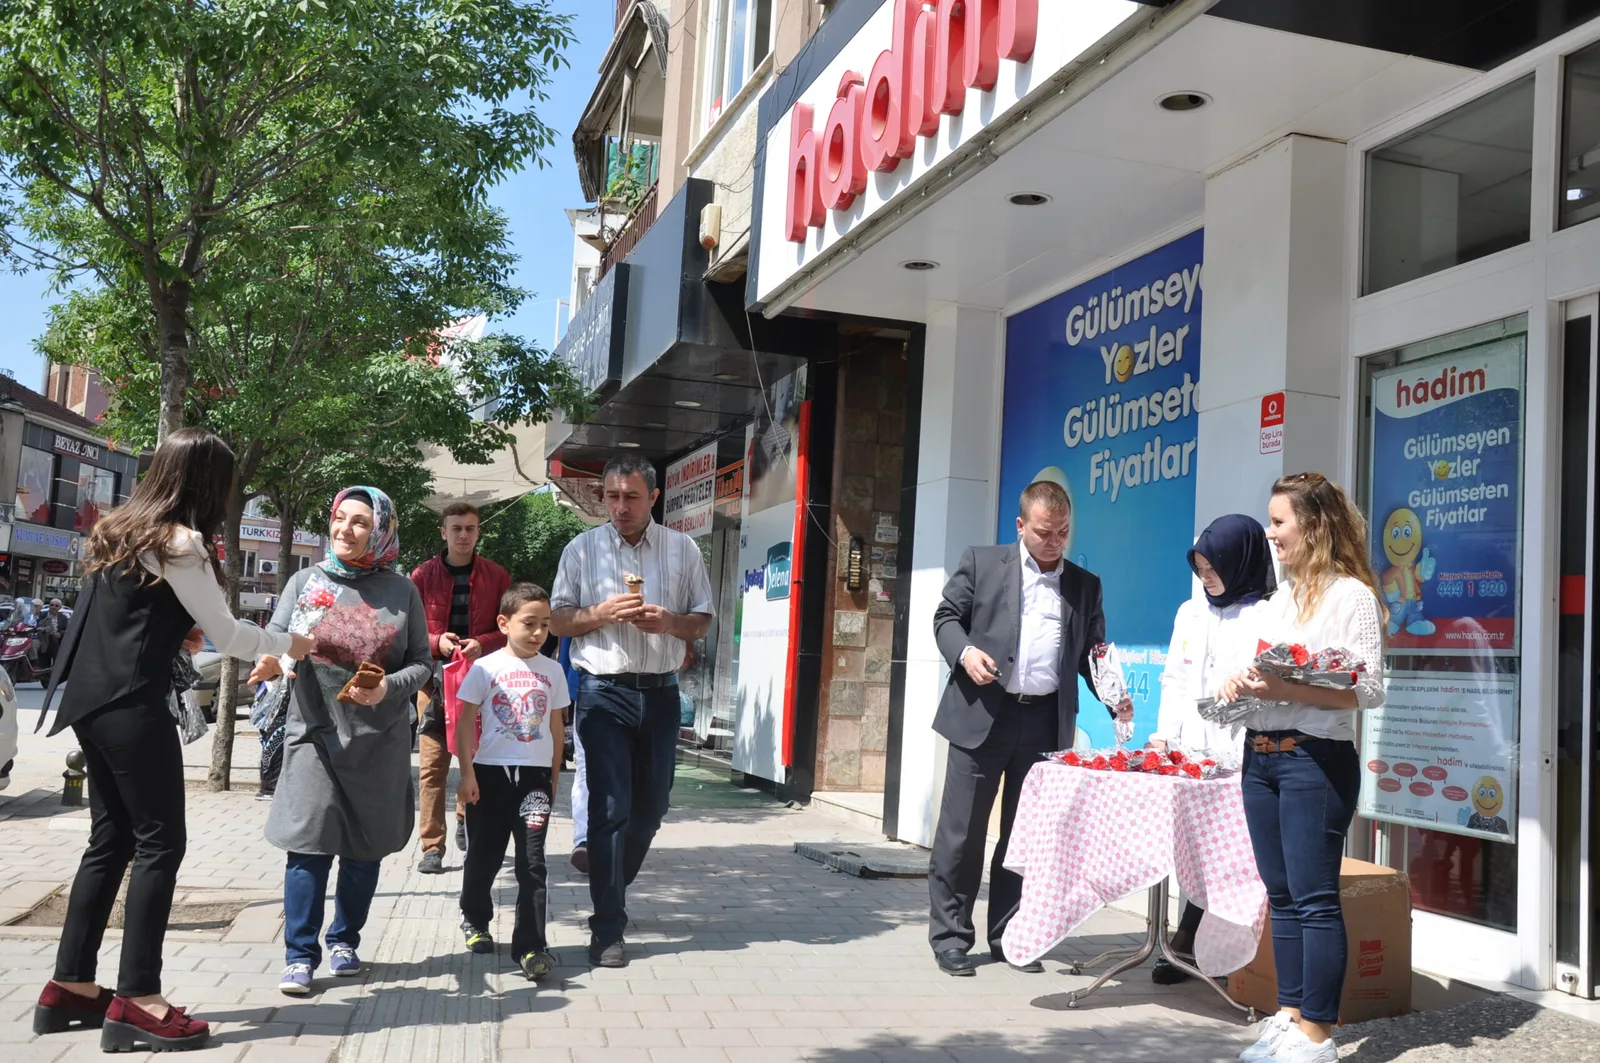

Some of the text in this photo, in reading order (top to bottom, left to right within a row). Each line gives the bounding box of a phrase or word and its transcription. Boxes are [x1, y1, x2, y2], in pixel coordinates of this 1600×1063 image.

[1264, 413, 1281, 421] vodafone
[54, 434, 80, 453] BEYAZ
[1261, 430, 1283, 440] Cep Lira
[1403, 426, 1510, 460] Gülümseyen
[1262, 440, 1281, 449] burada
[1089, 436, 1197, 503] Fiyatlar
[1408, 482, 1508, 508] Gülümseten
[1426, 506, 1487, 530] Fiyatlar
[1437, 580, 1507, 597] 444 1 320
[1445, 631, 1505, 641] www.hadim.com.tr
[507, 680, 538, 688] anne
